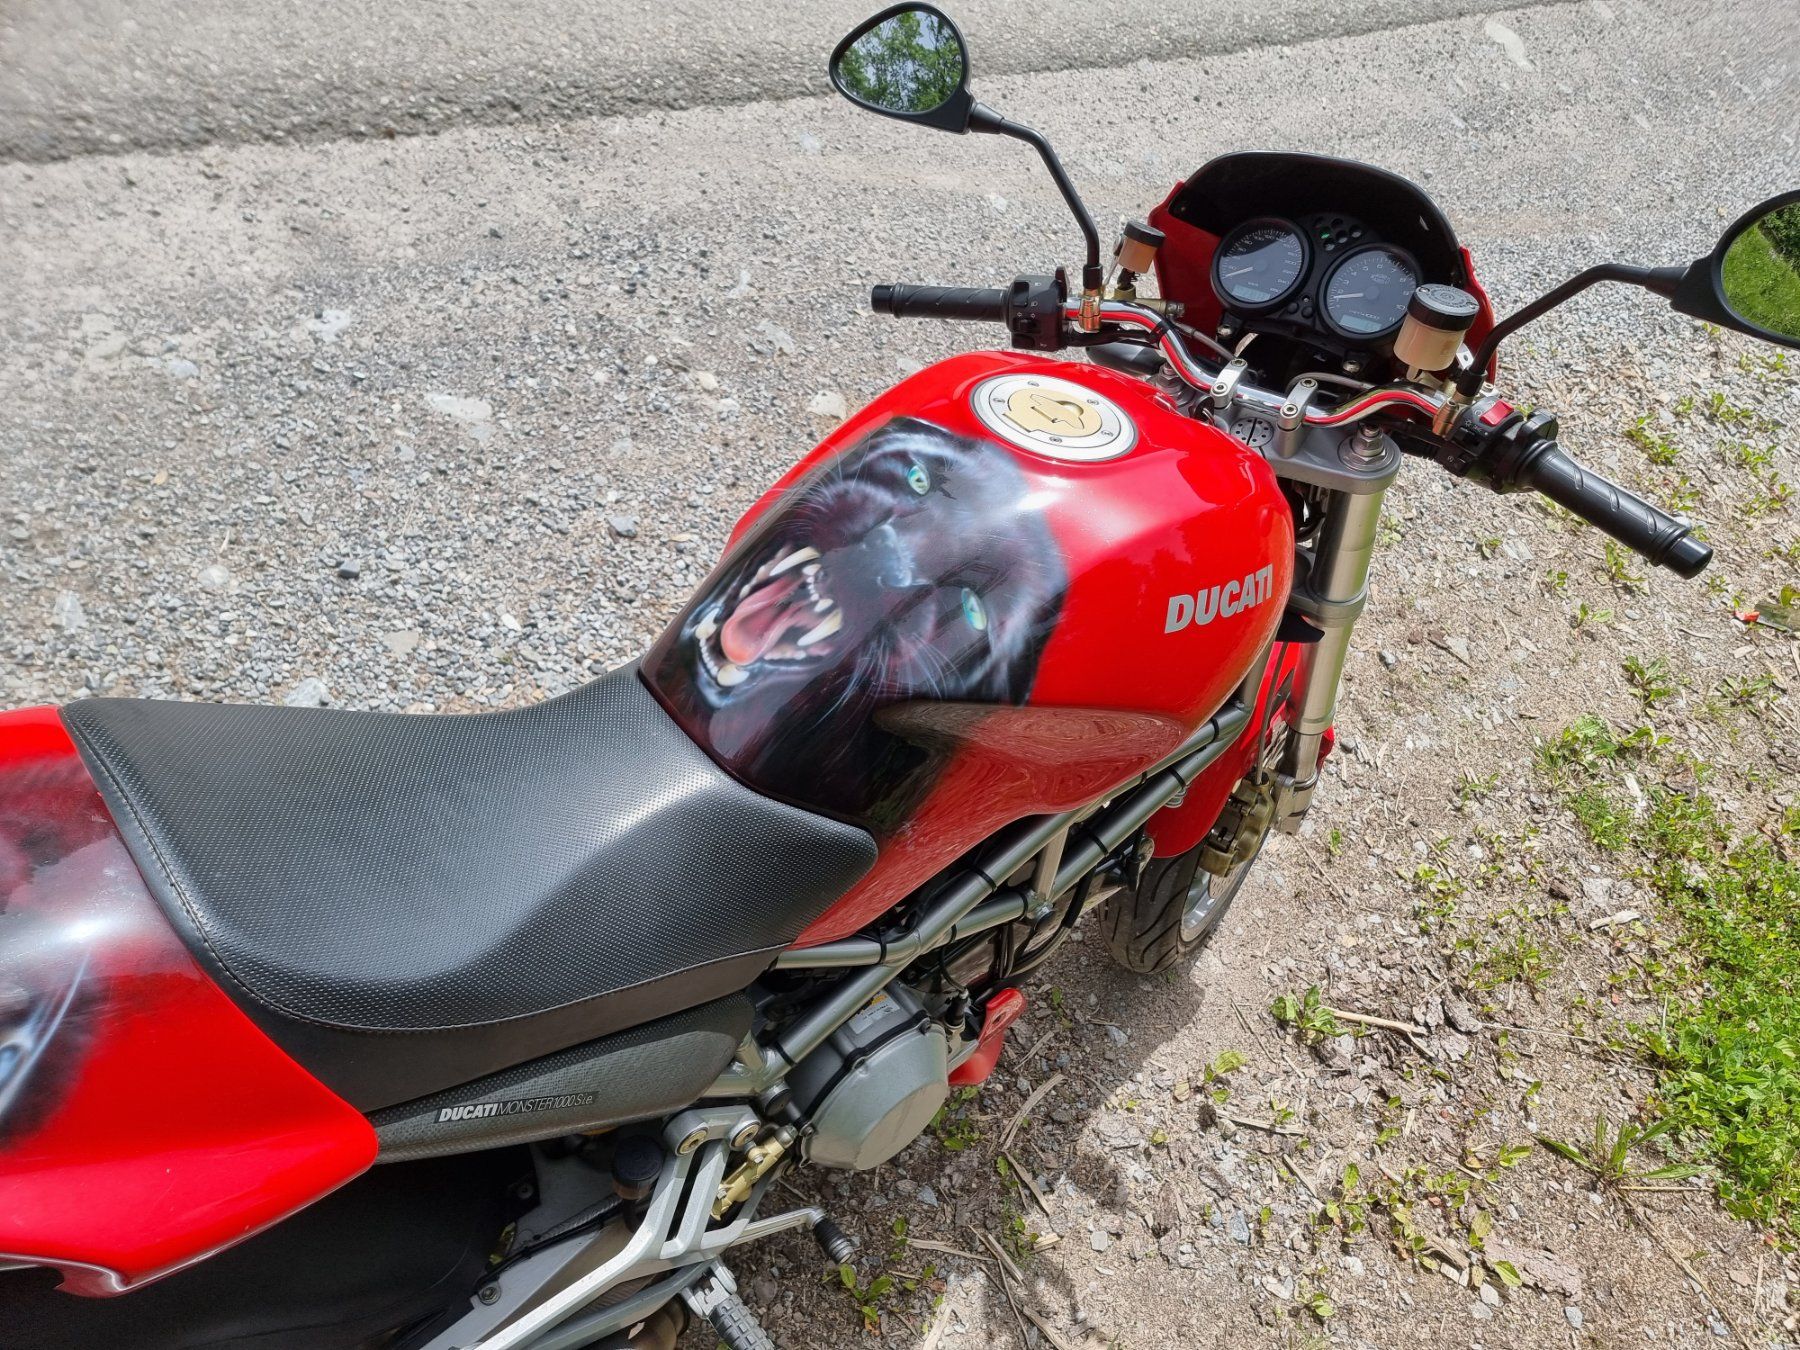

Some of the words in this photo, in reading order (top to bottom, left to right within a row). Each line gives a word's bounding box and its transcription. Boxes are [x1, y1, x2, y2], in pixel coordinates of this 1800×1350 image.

[1164, 564, 1273, 634] DUCATI
[438, 1103, 499, 1122] DUCATI
[496, 1097, 553, 1115] MONSTER
